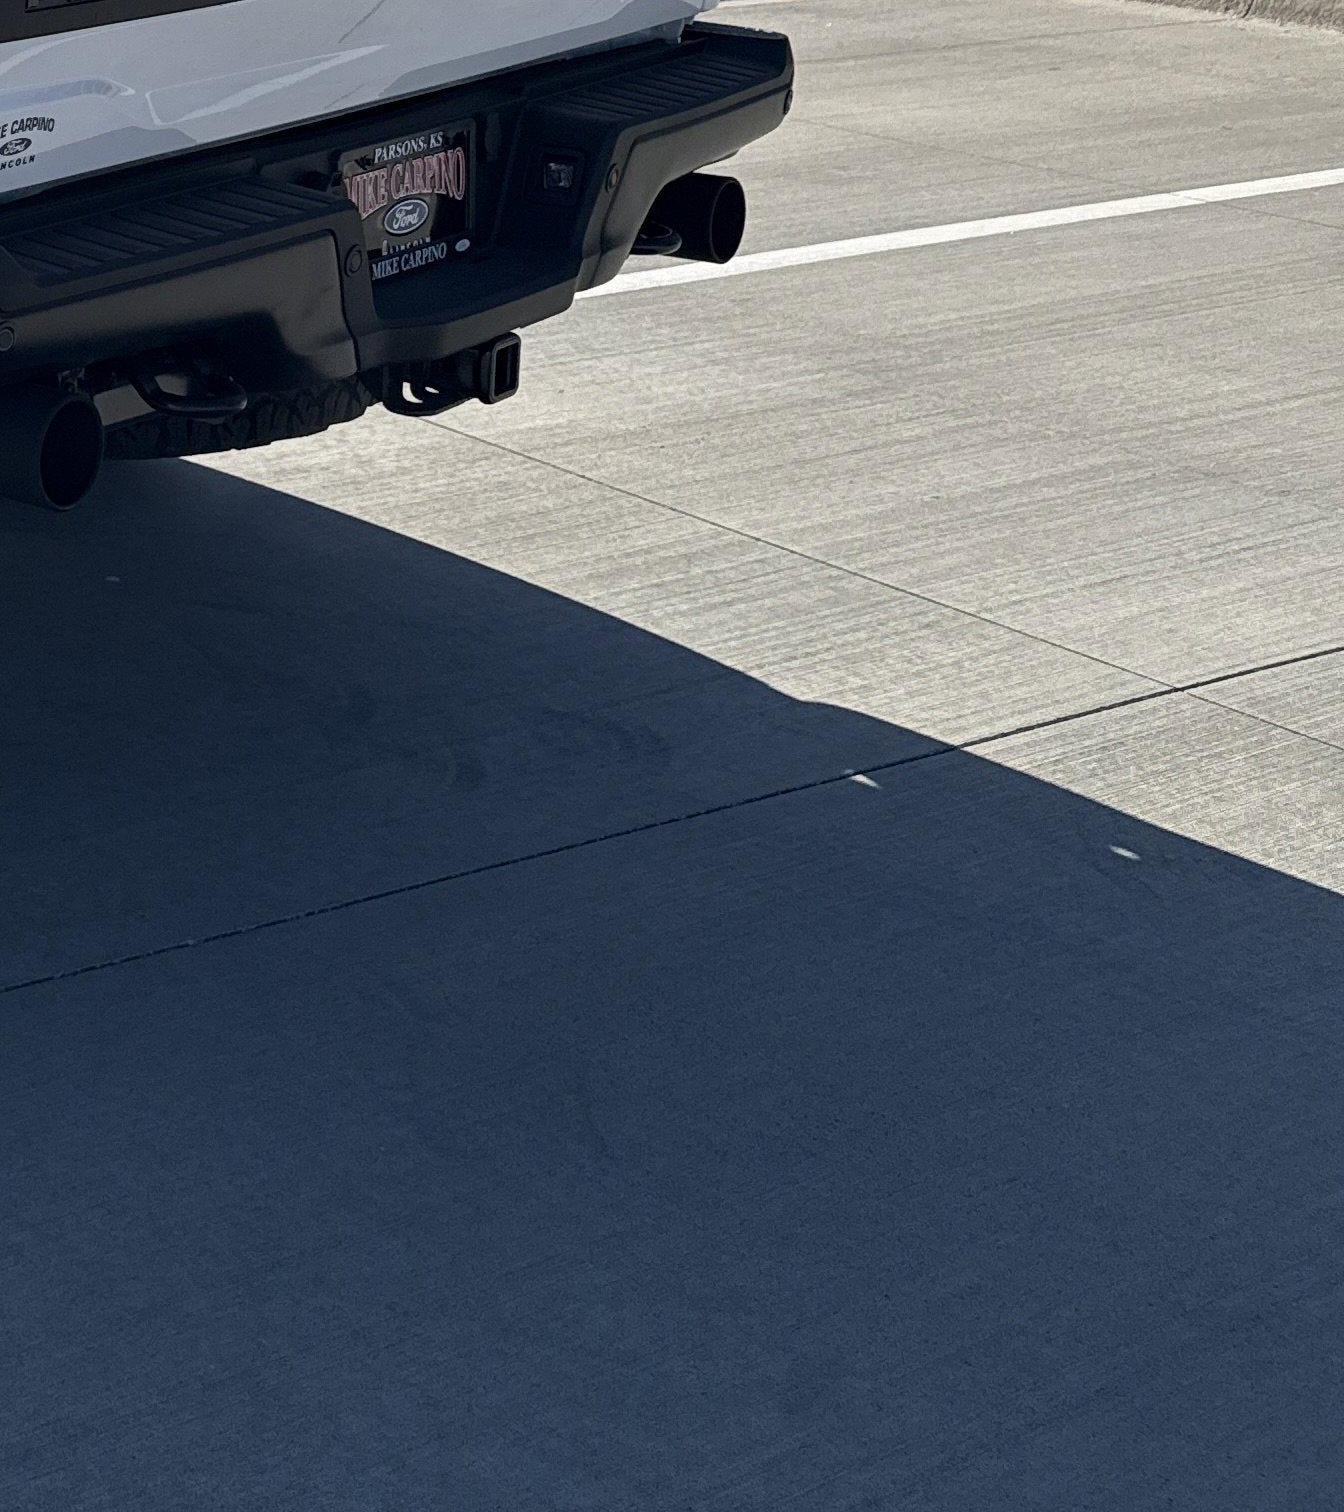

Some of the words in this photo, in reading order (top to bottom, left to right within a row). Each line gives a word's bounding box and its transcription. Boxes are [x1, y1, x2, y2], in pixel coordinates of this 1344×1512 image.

[11, 117, 55, 135] CARPINO
[374, 136, 428, 163] PARSONS,
[430, 131, 444, 148] KS
[344, 167, 388, 220] MIKE
[391, 147, 465, 200] CARPINO
[392, 204, 421, 229] Ford
[372, 257, 400, 280] MIKE
[401, 242, 447, 271] CARPINO
